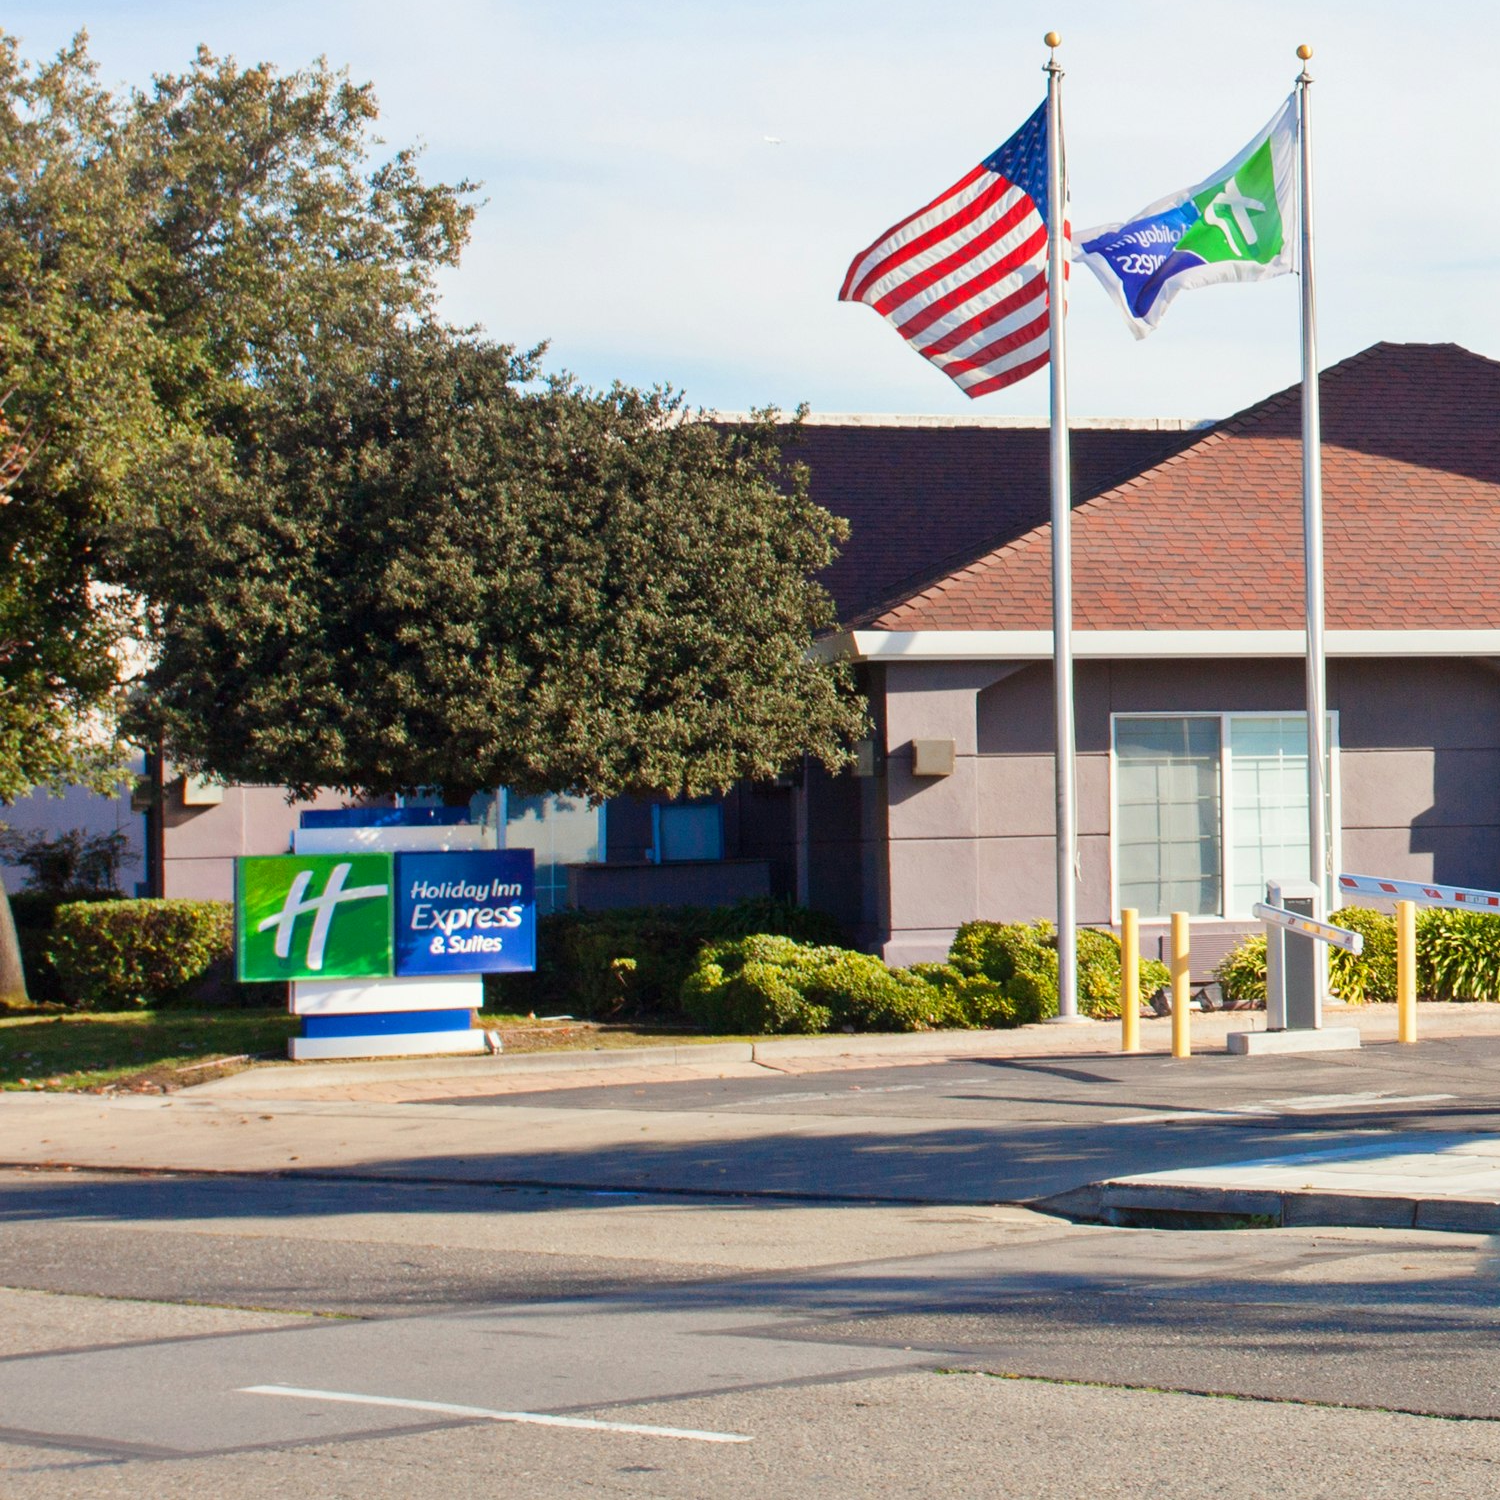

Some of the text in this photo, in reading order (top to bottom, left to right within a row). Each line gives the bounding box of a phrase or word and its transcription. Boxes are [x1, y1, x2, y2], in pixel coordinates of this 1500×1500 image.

[410, 878, 522, 902] Holiday Inn
[410, 903, 523, 937] Express
[429, 934, 503, 955] & Suites
